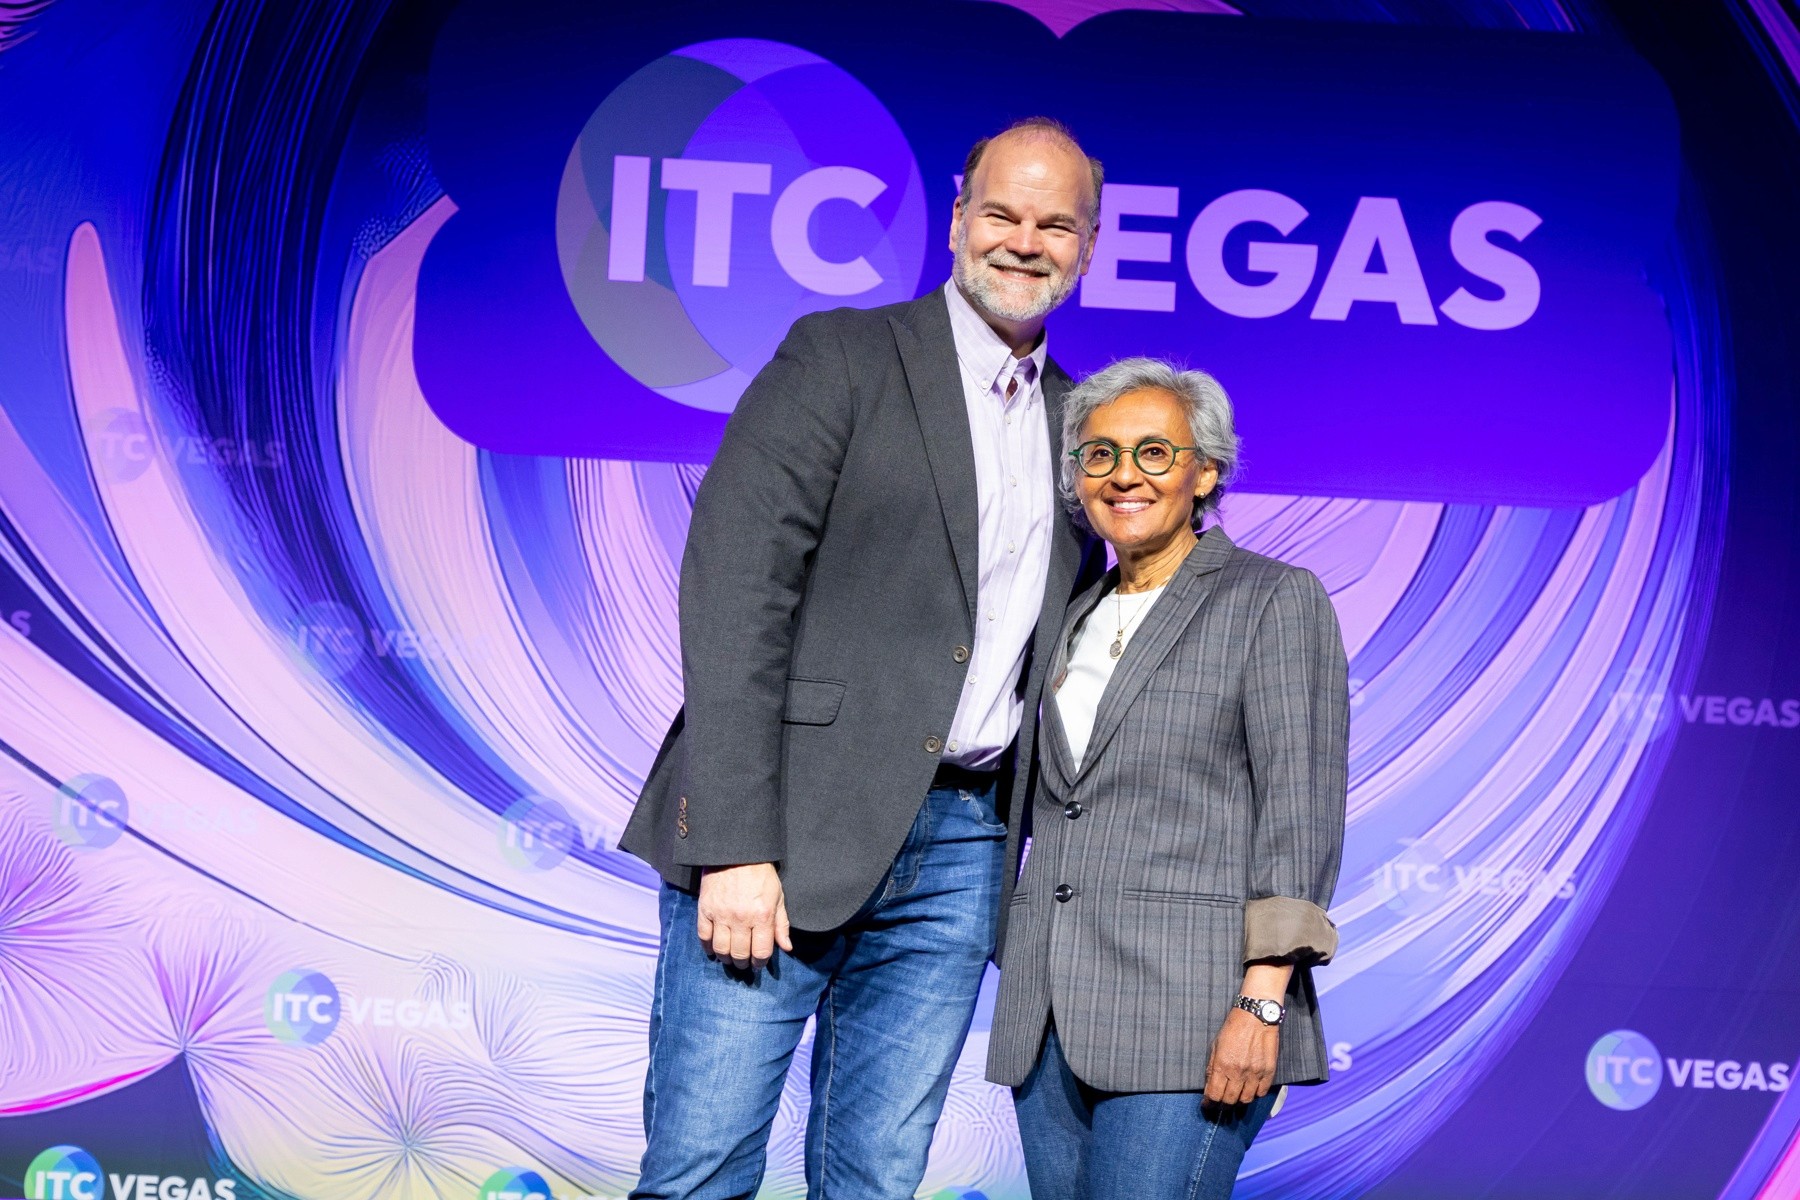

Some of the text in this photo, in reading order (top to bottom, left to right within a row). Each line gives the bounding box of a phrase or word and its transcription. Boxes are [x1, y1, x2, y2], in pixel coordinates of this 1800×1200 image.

[607, 154, 1543, 331] ITC EGAS
[1680, 694, 1800, 728] VEGAS
[59, 798, 120, 828] ITC
[506, 819, 566, 851] ITC
[1383, 861, 1441, 892] ITC
[272, 992, 472, 1030] ITC VEGAS
[1595, 1055, 1791, 1092] ITC VEGAS
[34, 1170, 236, 1200] ITC VEGAS
